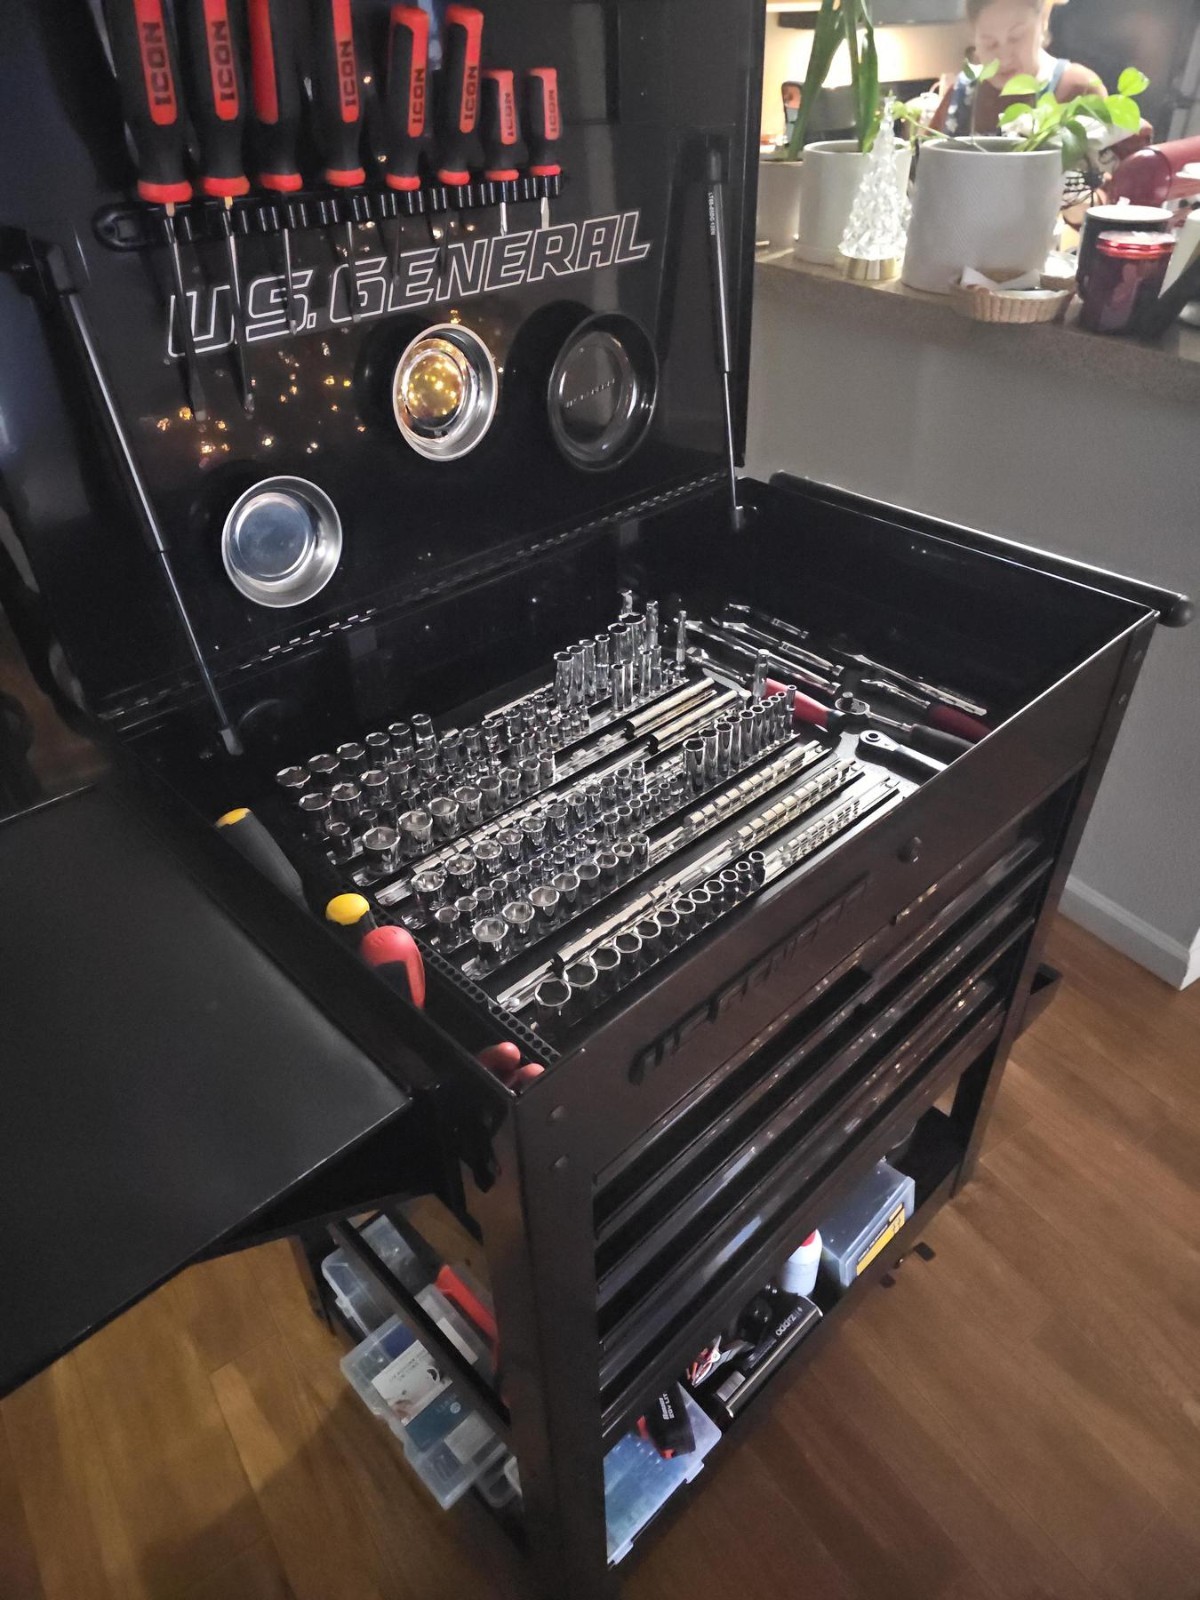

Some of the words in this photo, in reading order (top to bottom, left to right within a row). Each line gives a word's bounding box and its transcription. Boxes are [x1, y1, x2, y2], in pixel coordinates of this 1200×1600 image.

[142, 21, 171, 106] ICON
[211, 20, 235, 101] ICON
[339, 40, 357, 107] ICON
[412, 68, 425, 124] ICON
[464, 65, 477, 121] ICON
[504, 92, 515, 137] ICON
[548, 89, 557, 133] ICON
